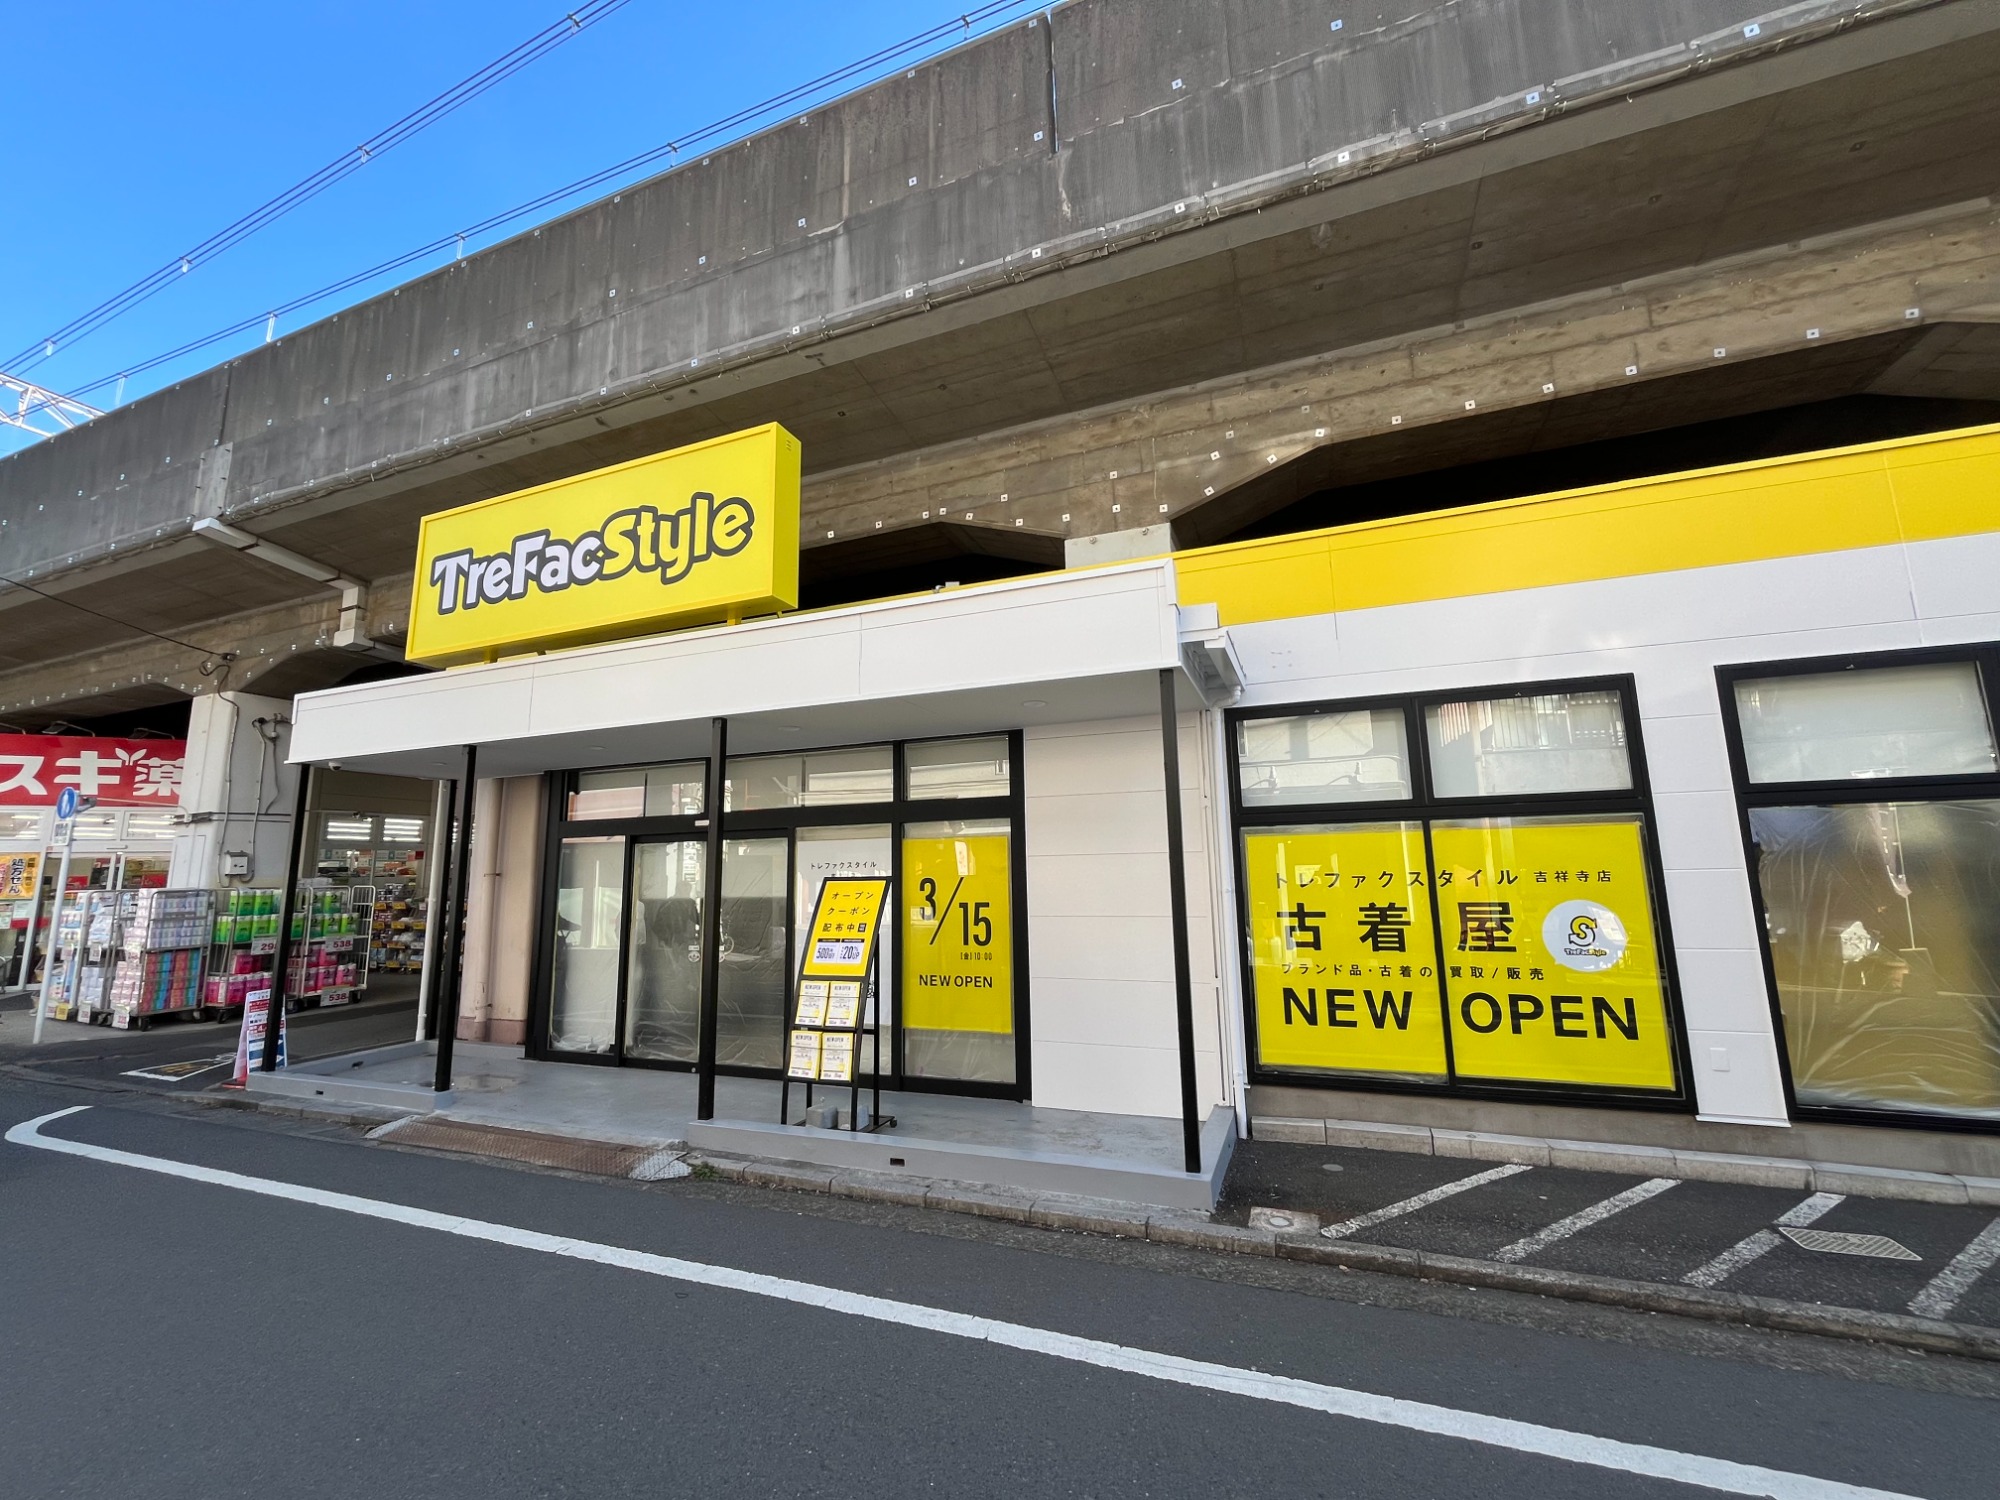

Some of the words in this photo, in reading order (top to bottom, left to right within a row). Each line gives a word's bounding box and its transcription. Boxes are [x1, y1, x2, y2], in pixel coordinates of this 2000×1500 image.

[811, 861, 877, 870] トレファクスタイル
[1275, 869, 1519, 888] トレファクスタイル
[1533, 869, 1612, 884] 吉祥寺店
[919, 876, 993, 947] 3/15
[1276, 902, 1518, 953] 古着屋
[919, 975, 951, 987] NEW
[954, 976, 993, 989] OPEN
[1283, 987, 1413, 1031] NEW
[1460, 992, 1639, 1041] OPEN
